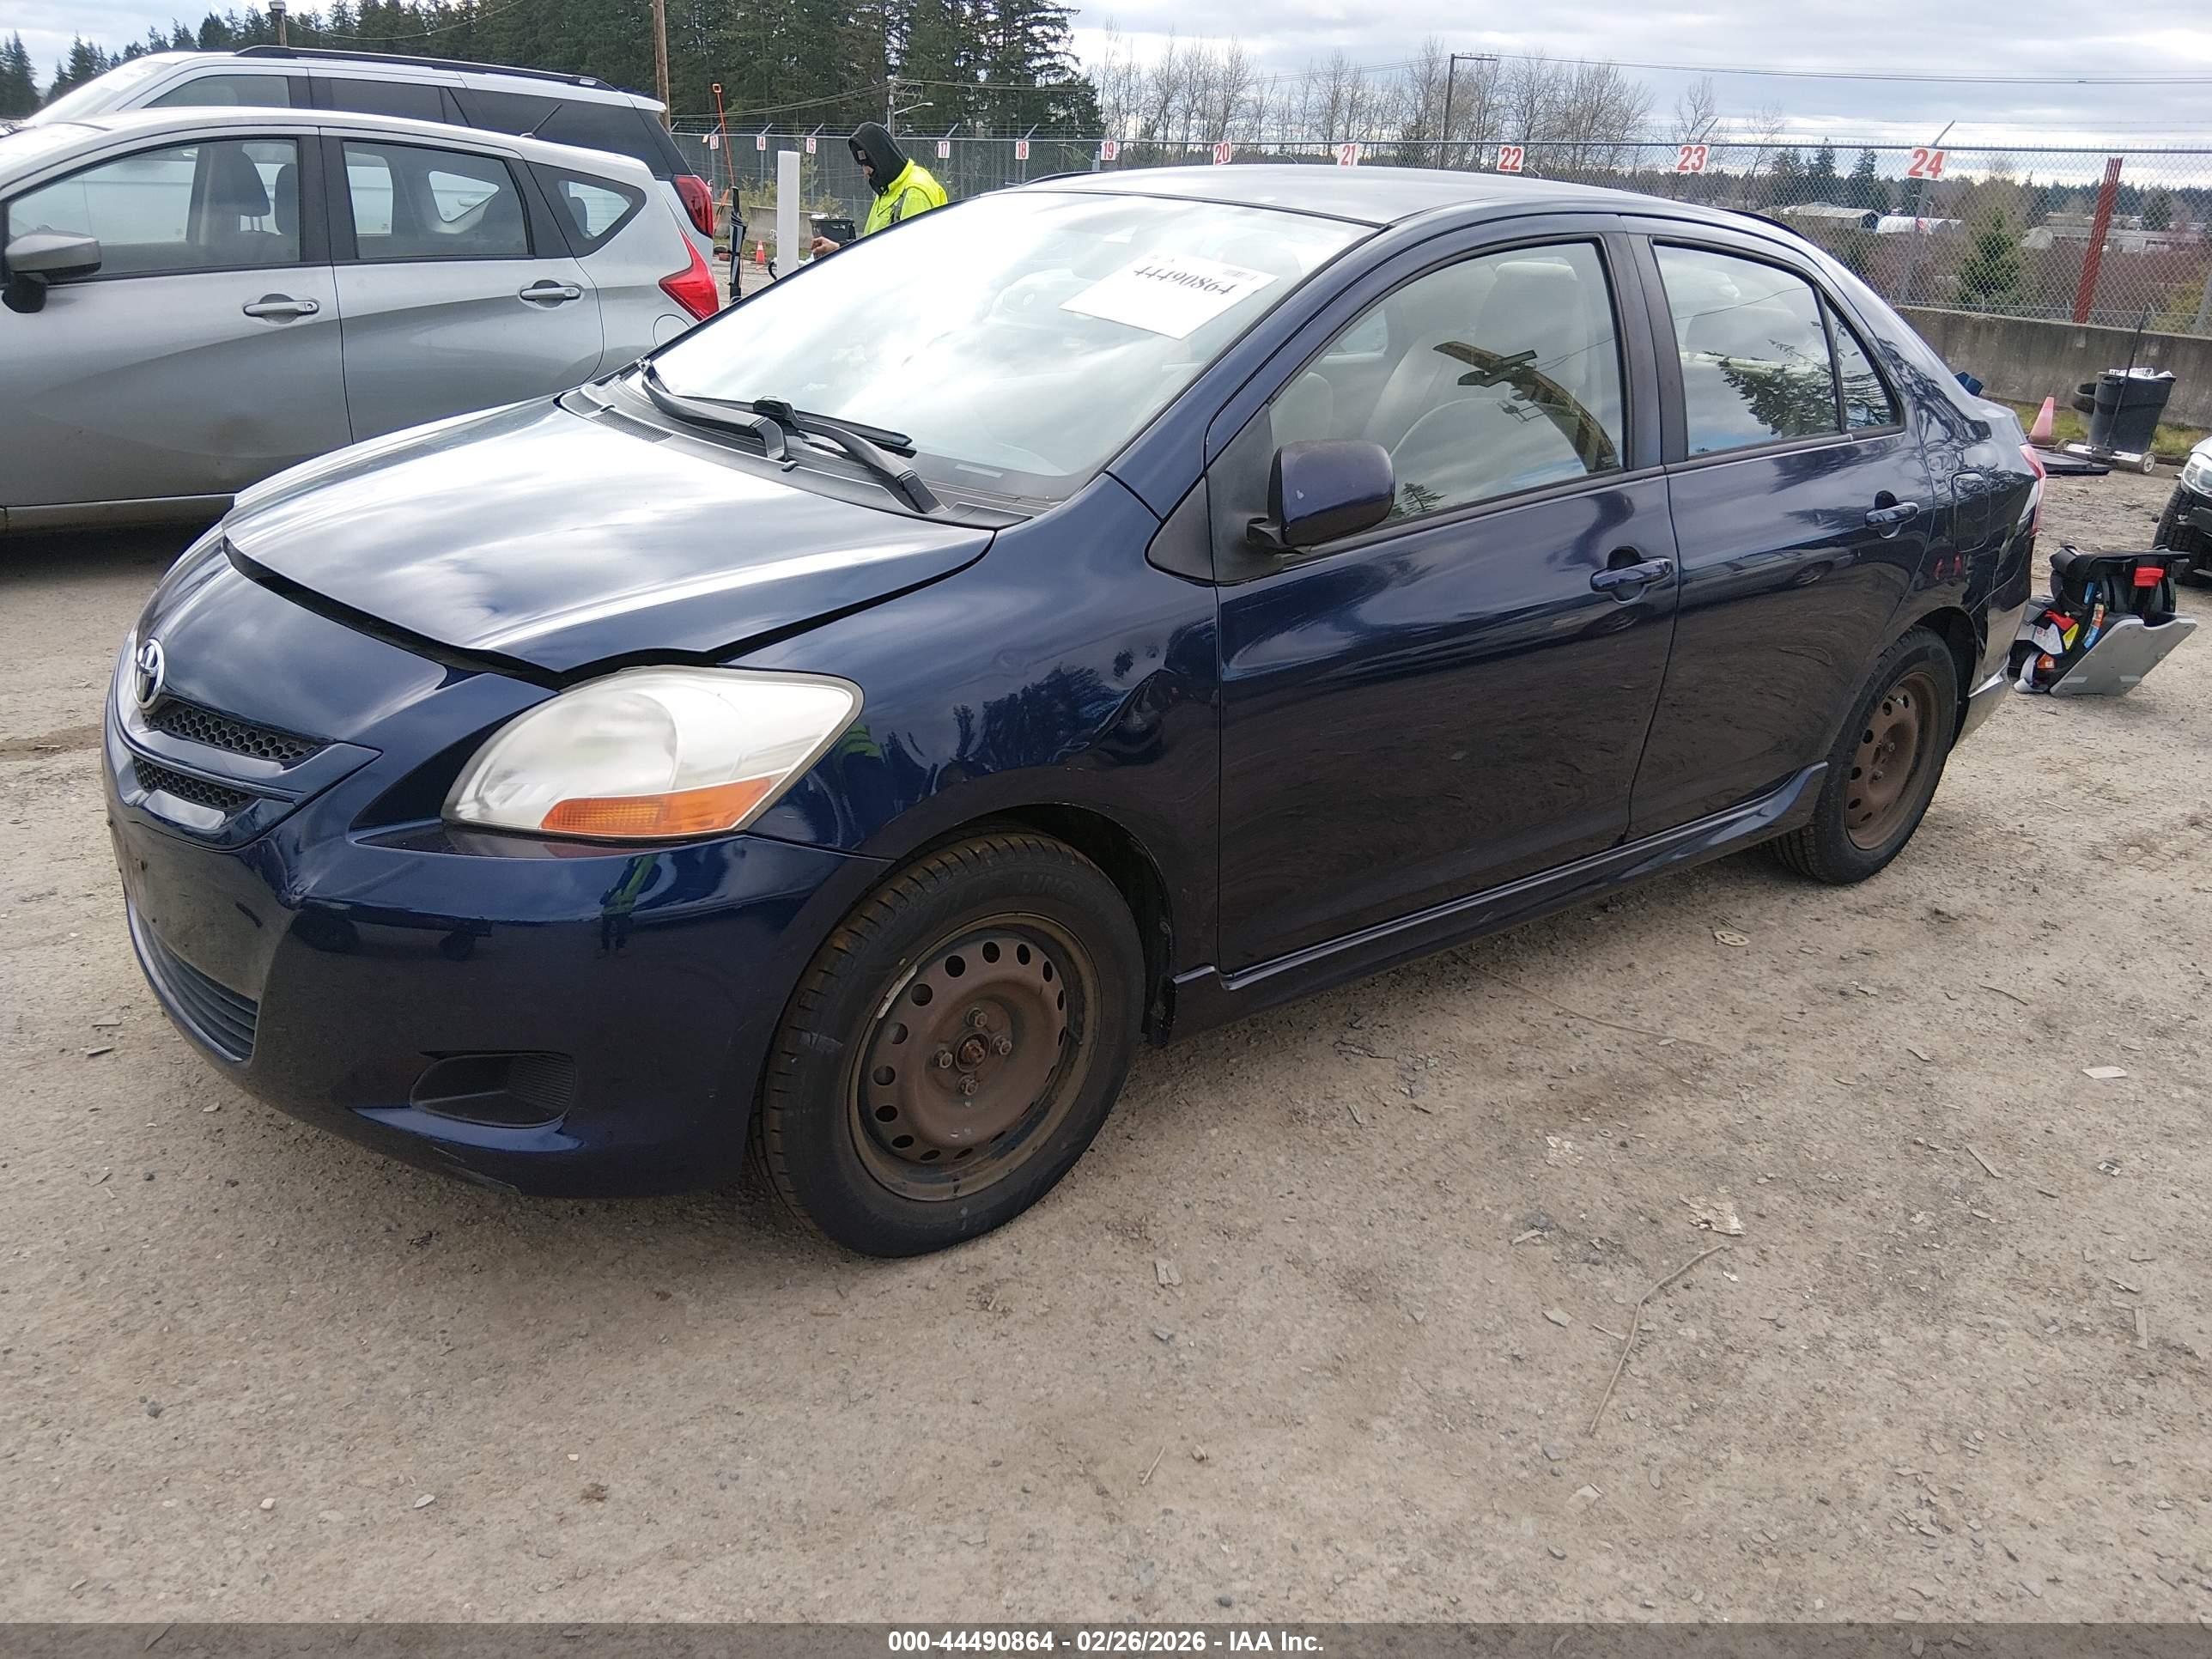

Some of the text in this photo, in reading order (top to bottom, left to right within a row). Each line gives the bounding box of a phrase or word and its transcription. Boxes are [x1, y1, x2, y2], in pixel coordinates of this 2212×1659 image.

[758, 137, 764, 149] 14
[808, 138, 815, 153] 15
[940, 143, 948, 157] 17
[1017, 143, 1028, 160] 18
[1103, 142, 1115, 160] 19
[1214, 143, 1231, 164] 20
[1340, 144, 1357, 166] 21
[1498, 146, 1522, 170] 22
[1677, 146, 1706, 172] 23
[1908, 149, 1945, 179] 24
[1133, 265, 1238, 295] 44490864
